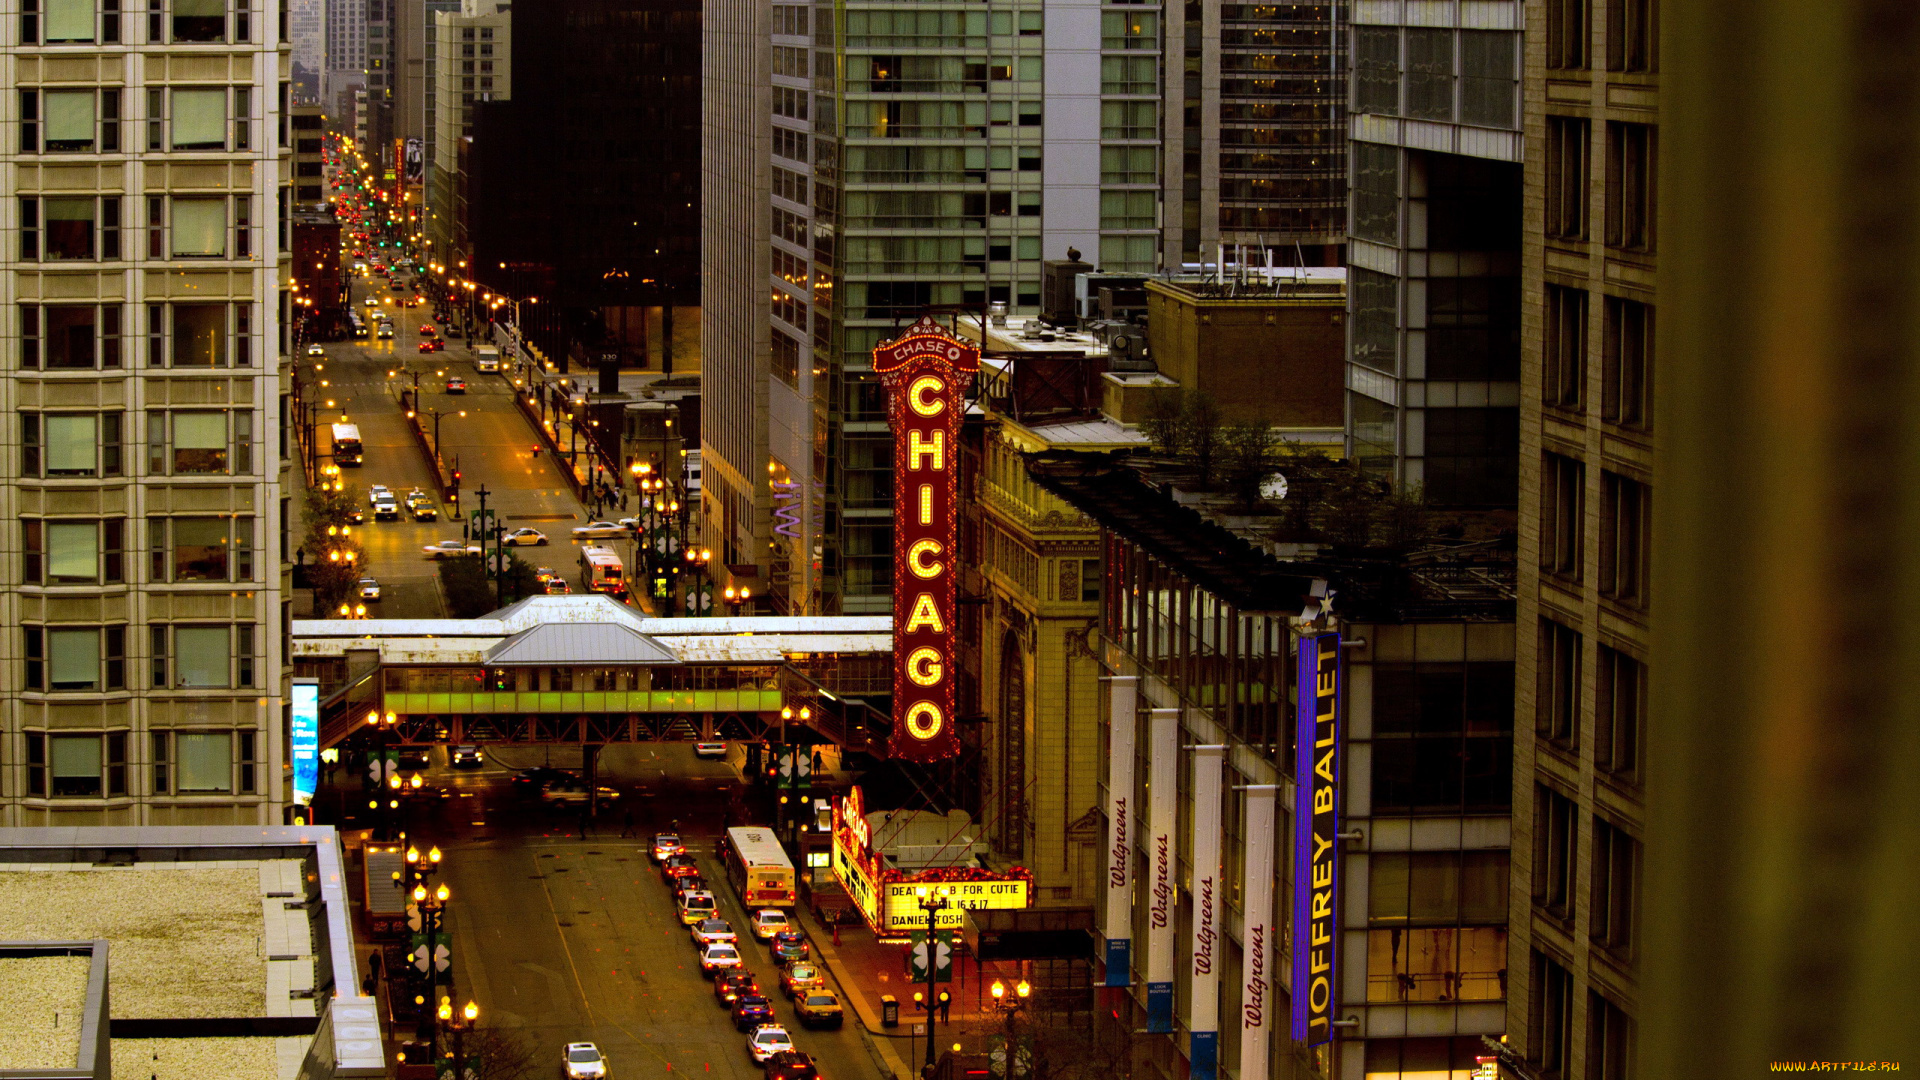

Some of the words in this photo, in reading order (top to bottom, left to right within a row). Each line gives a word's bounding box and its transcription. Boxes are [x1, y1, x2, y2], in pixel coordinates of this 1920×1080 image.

[893, 341, 946, 361] CHASE
[904, 375, 946, 741] CHICAGO
[1314, 643, 1336, 815] BALLET
[892, 886, 919, 897] DEAT
[935, 885, 956, 895] CB
[963, 885, 983, 895] FOR
[990, 884, 1019, 894] CUTIE
[1110, 797, 1131, 889] Walgreens
[1151, 834, 1173, 930] Walgreens
[936, 915, 962, 924] TOSH
[957, 900, 966, 910] 16
[970, 900, 977, 909] &
[980, 900, 988, 909] 17
[1194, 876, 1217, 976] Walgreens
[1309, 831, 1333, 1035] JOFFREY
[1244, 924, 1268, 1029] Walgreens
